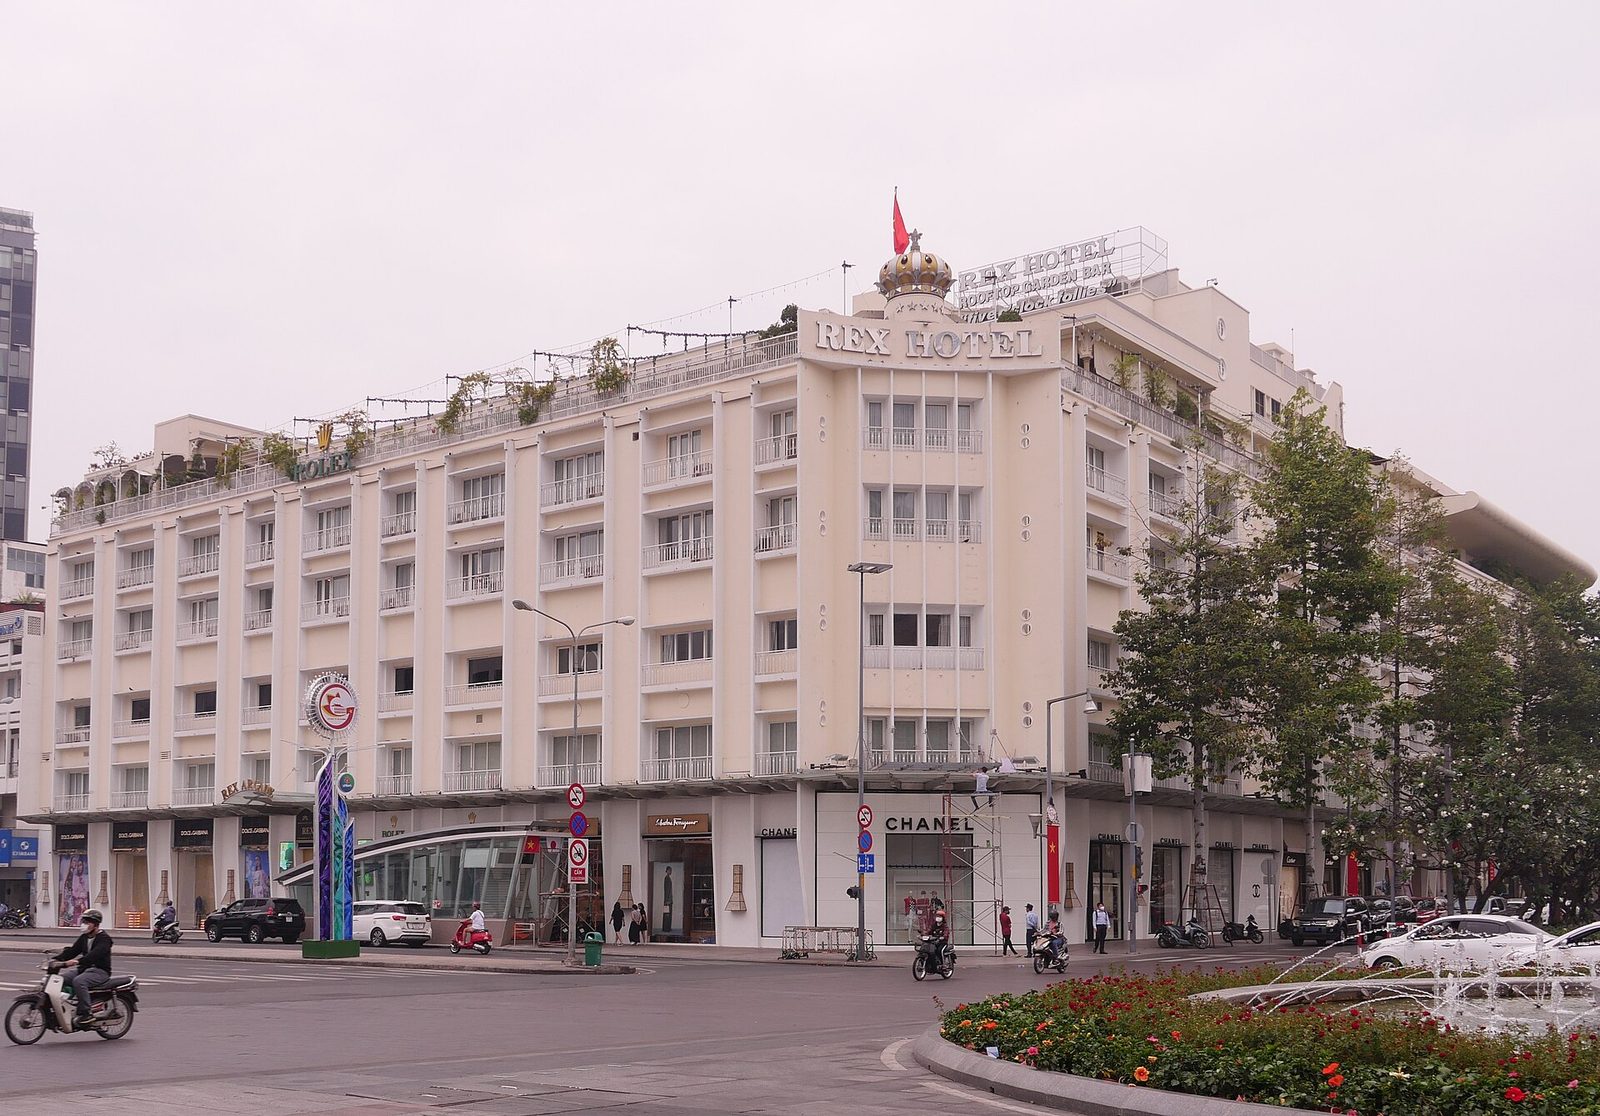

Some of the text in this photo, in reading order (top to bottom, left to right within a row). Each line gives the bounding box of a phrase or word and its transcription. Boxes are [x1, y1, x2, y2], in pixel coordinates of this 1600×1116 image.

[958, 237, 1115, 292] REX HOTEL
[959, 262, 1112, 309] ROOFTOP GARDEN BAR
[816, 320, 1042, 359] REX HOTEL
[293, 451, 354, 482] ROLEX
[221, 782, 239, 799] REX
[761, 828, 797, 837] CHANE
[885, 817, 974, 831] CHANEL
[1098, 833, 1121, 841] CHANEL
